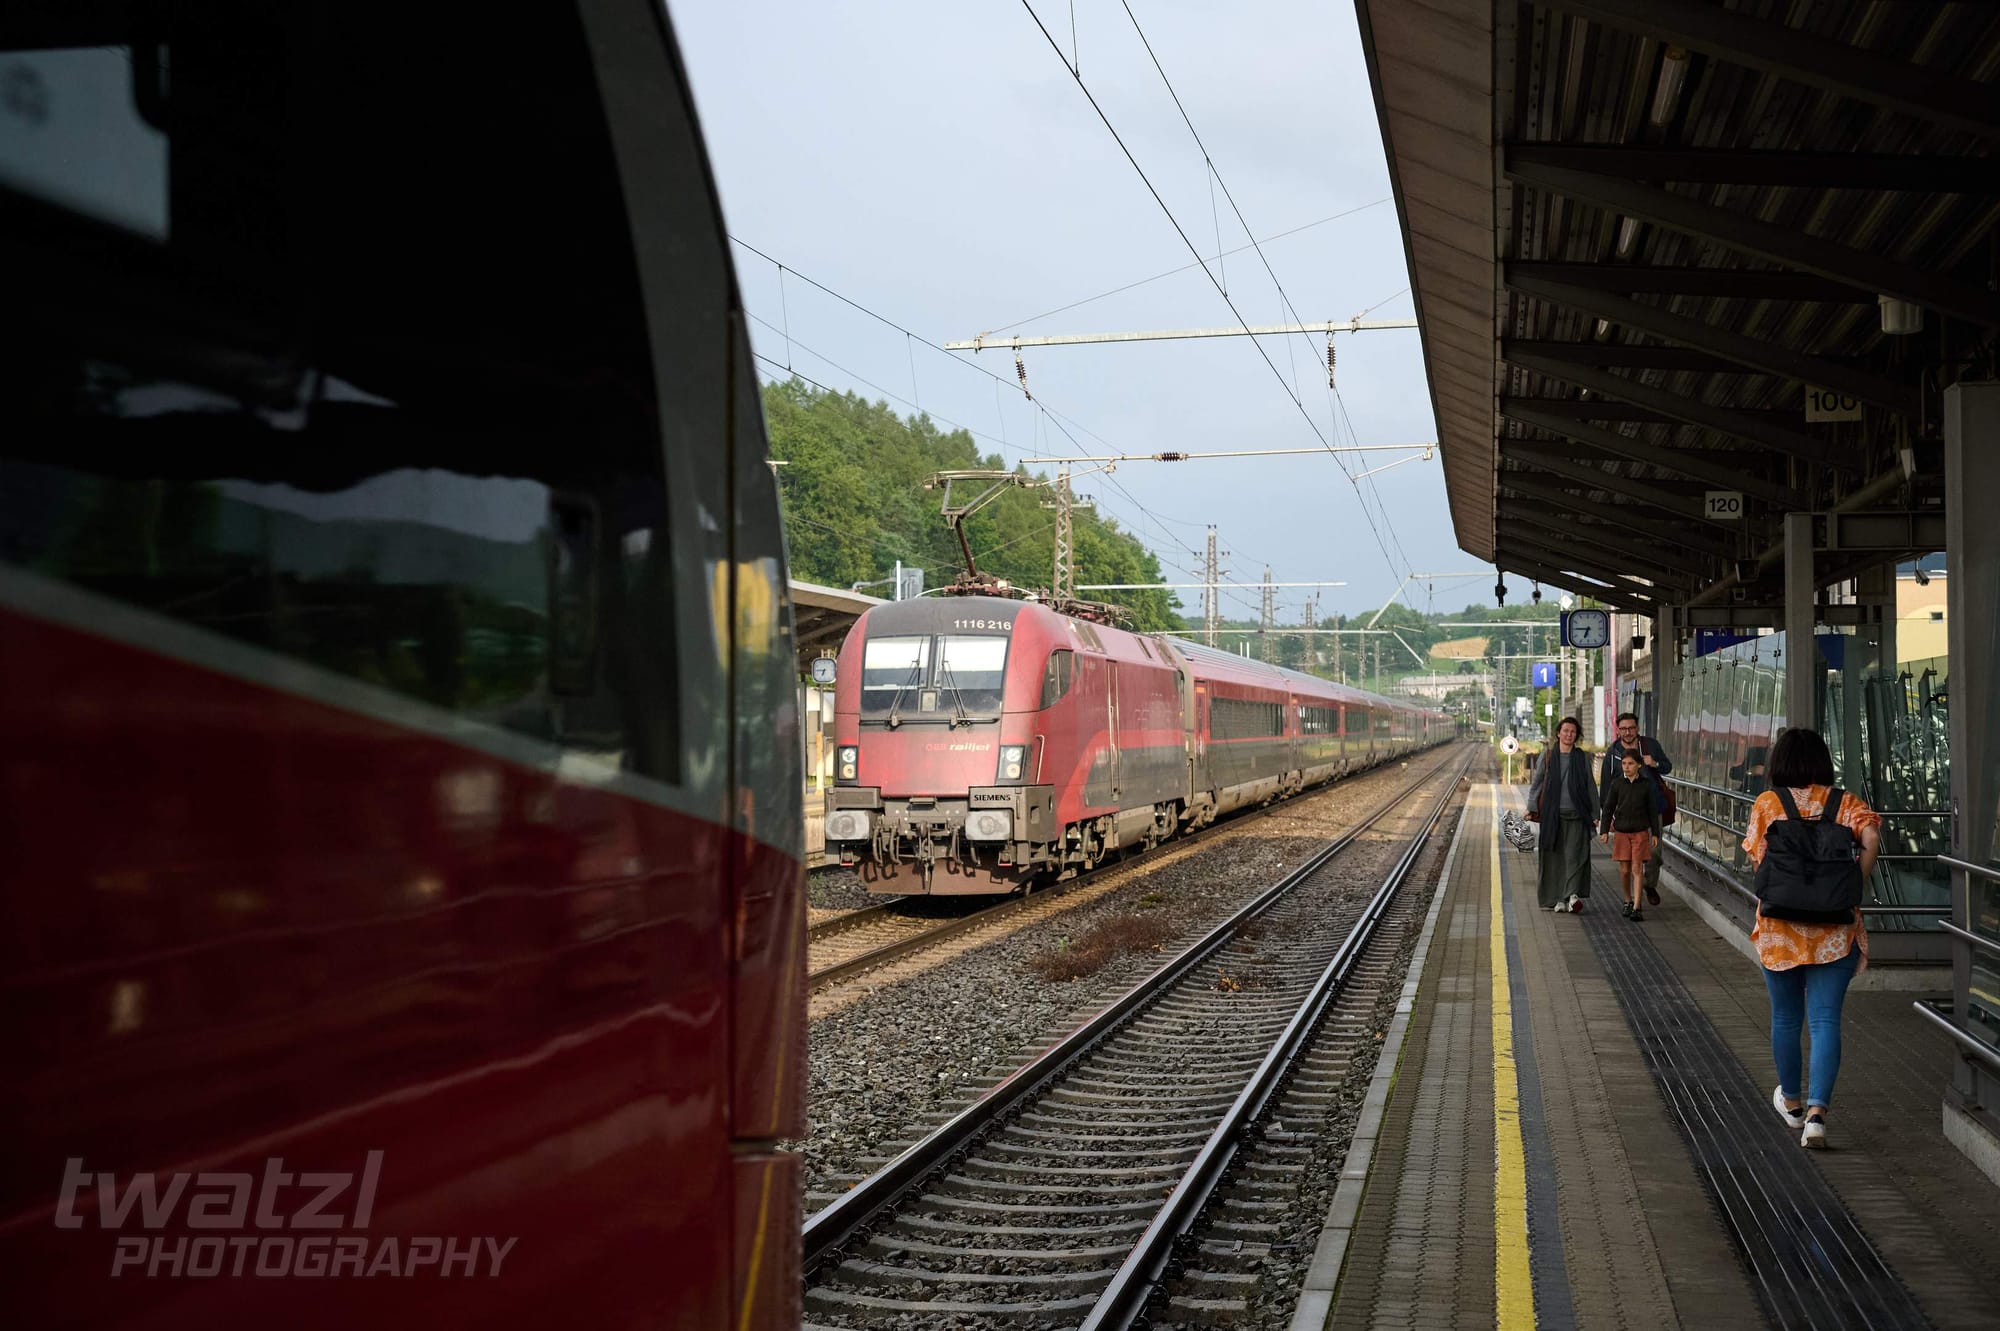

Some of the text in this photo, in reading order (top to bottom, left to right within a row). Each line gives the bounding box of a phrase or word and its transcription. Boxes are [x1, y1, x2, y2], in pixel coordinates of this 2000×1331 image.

[1809, 391, 1856, 411] 100
[1709, 498, 1739, 512] 120
[953, 619, 1012, 631] 1116 216
[1540, 667, 1548, 683] 1
